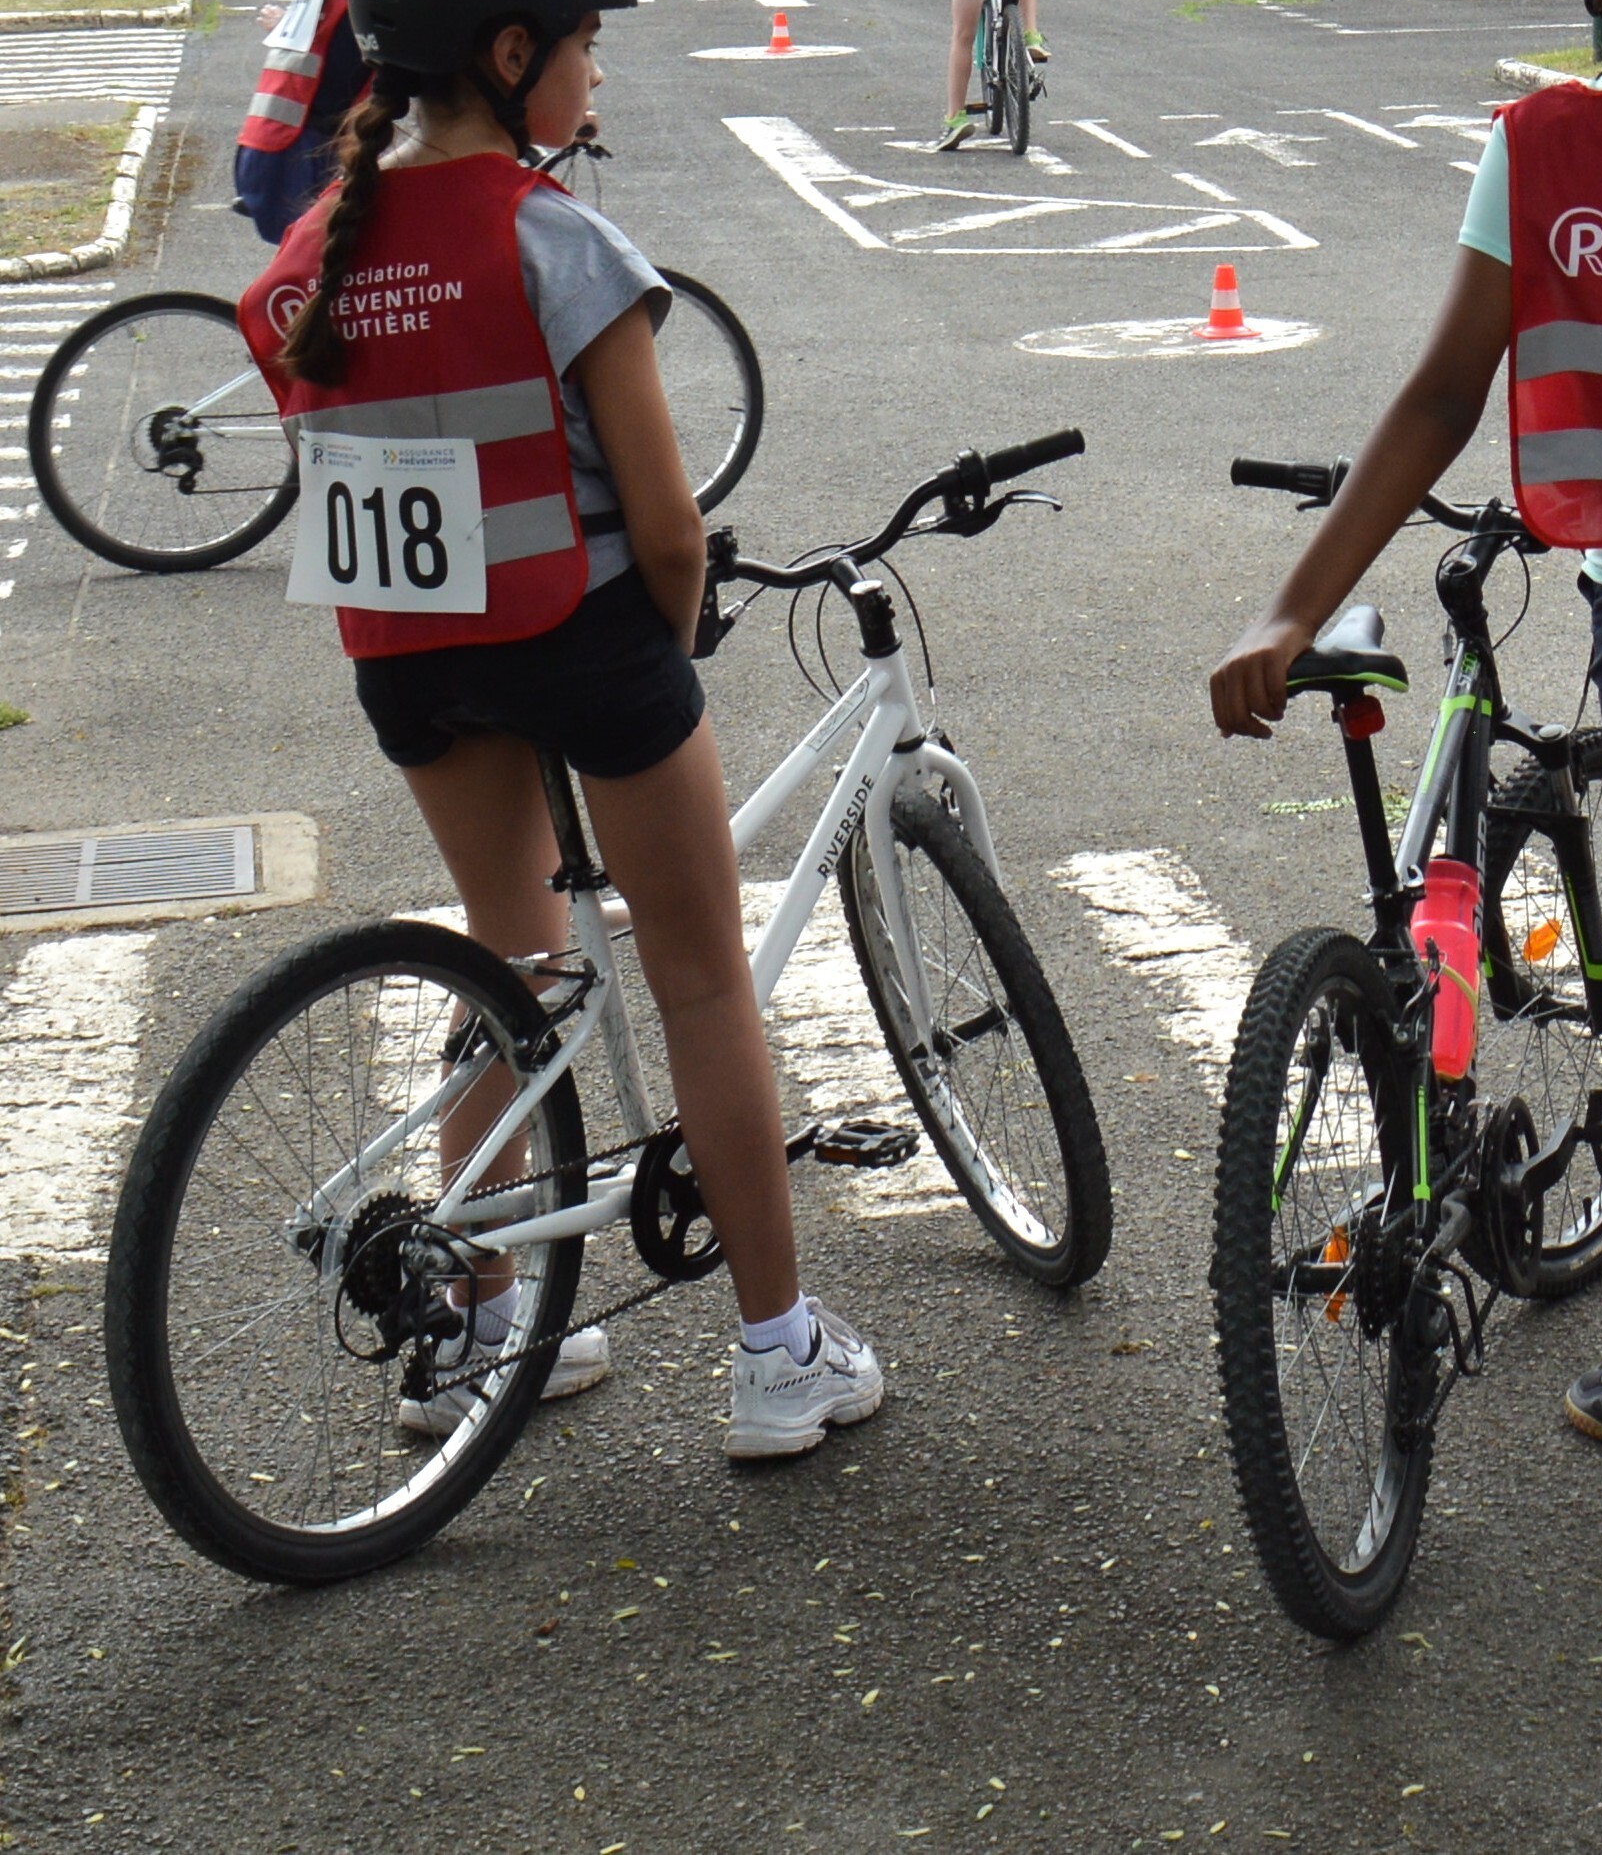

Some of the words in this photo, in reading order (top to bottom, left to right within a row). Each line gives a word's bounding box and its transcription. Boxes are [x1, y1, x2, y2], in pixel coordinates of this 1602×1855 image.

[329, 280, 462, 317] ÉVENTION
[342, 310, 430, 340] UTIÈRE
[399, 448, 455, 456] ASSURANCE
[399, 456, 456, 465] PRÉVENTION
[327, 481, 448, 589] 018
[817, 774, 874, 879] RIVERSIDE
